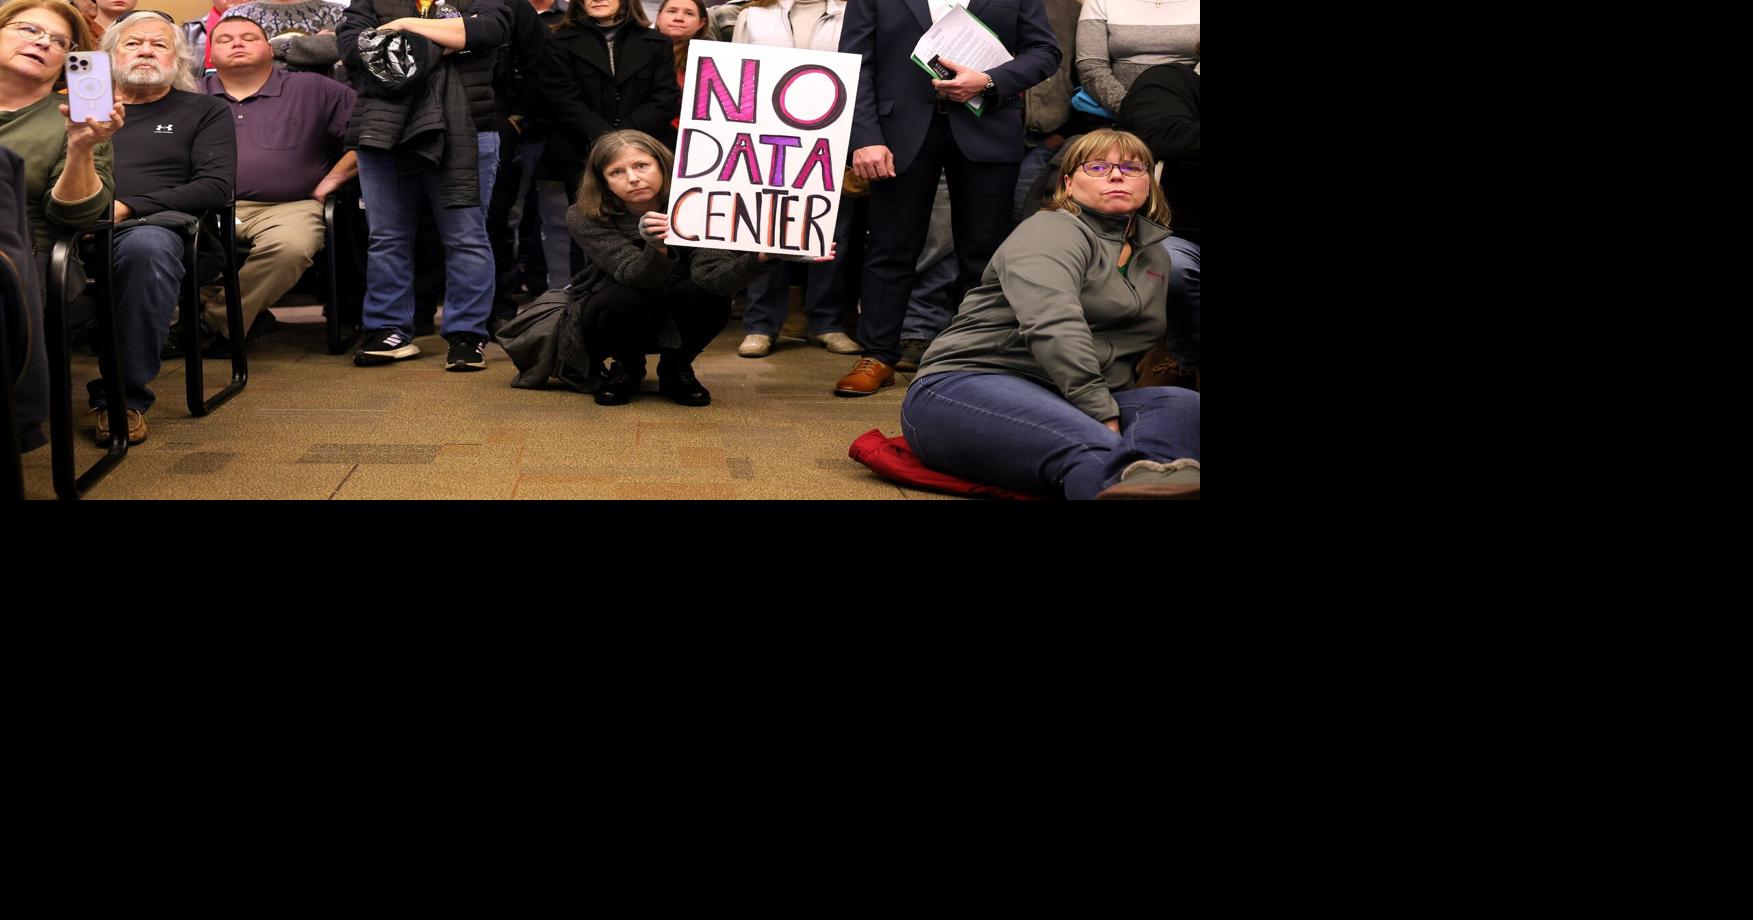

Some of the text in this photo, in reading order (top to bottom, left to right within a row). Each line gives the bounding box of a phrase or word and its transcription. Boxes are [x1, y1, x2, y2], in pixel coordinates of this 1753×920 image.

[692, 56, 847, 131] NO
[677, 128, 835, 192] DATA
[671, 188, 832, 257] CENTER
